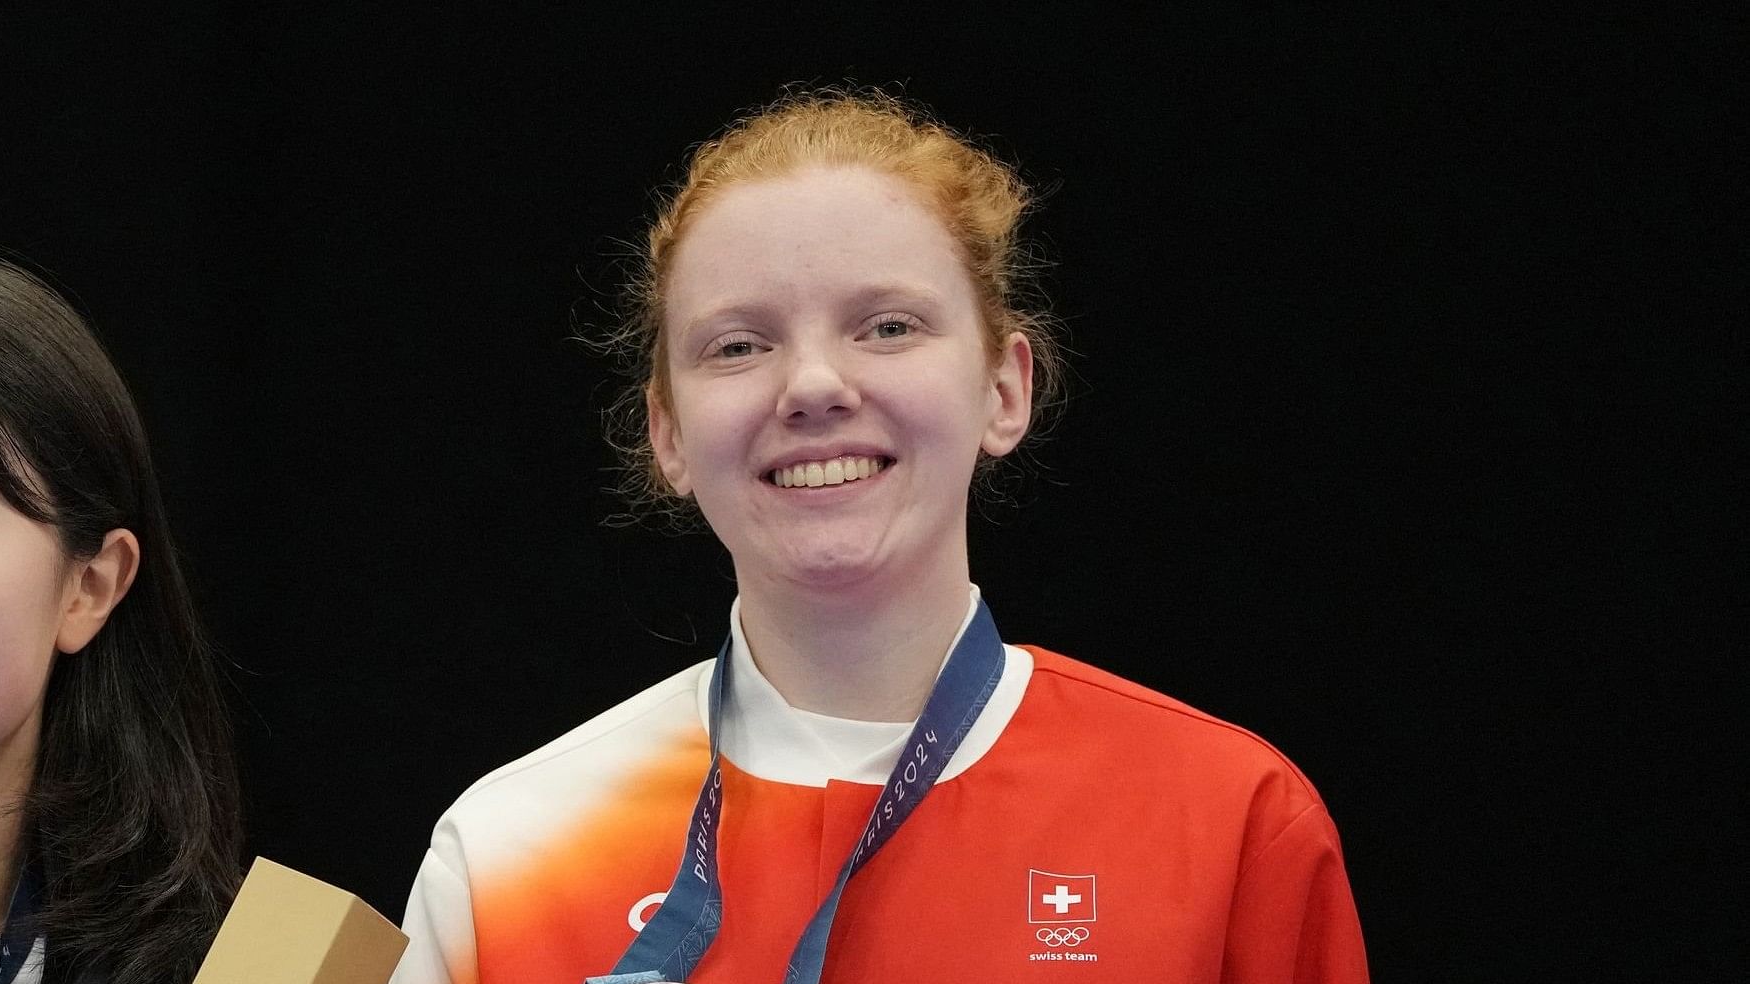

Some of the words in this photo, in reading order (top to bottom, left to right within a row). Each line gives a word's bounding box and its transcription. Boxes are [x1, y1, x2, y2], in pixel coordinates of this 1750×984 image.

[894, 730, 938, 801] 2024
[1029, 951, 1062, 961] swiss
[1065, 952, 1098, 962] team
